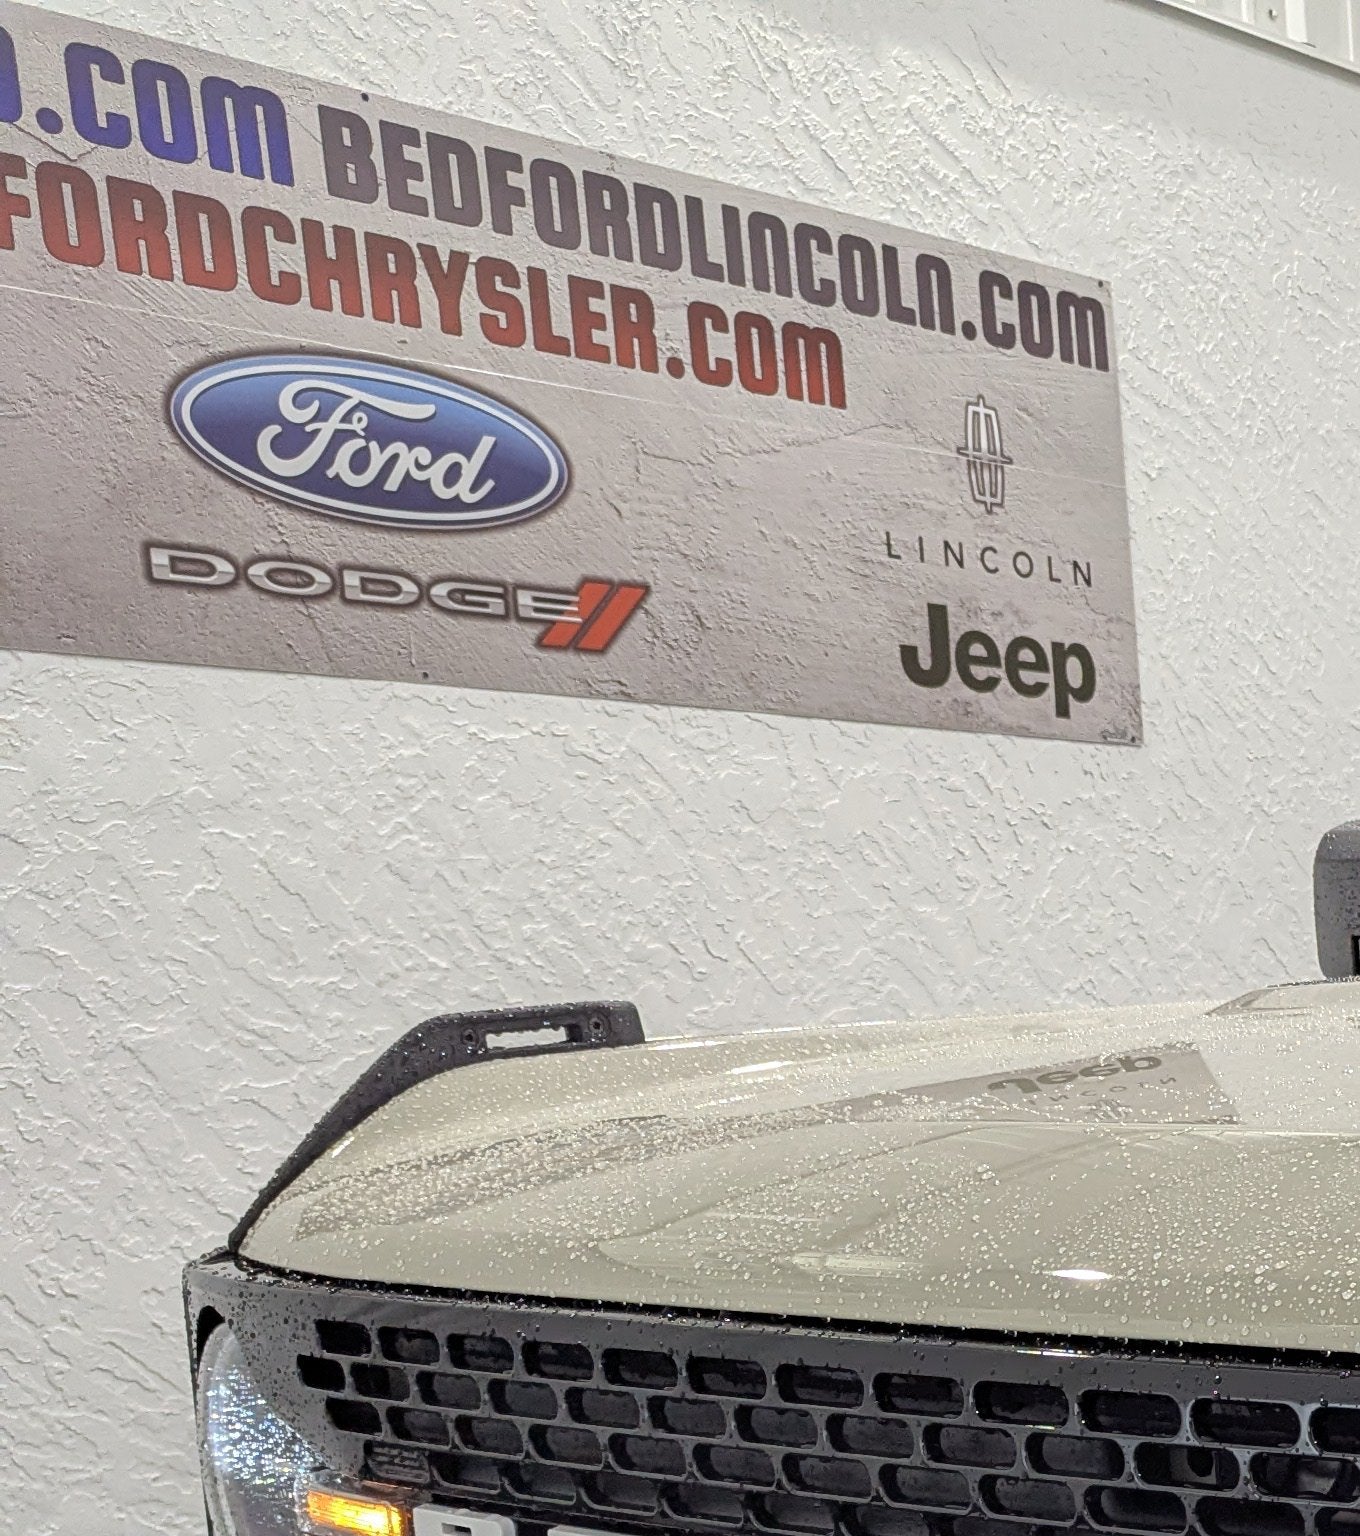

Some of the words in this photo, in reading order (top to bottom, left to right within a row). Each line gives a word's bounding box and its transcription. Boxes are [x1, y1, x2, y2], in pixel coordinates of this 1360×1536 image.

[317, 103, 1110, 372] BEDFORDLINCOLN.COM
[254, 378, 500, 505] Ford
[146, 544, 584, 626] DODGE
[884, 530, 1095, 588] LINCOLN
[899, 603, 1097, 718] Jeep
